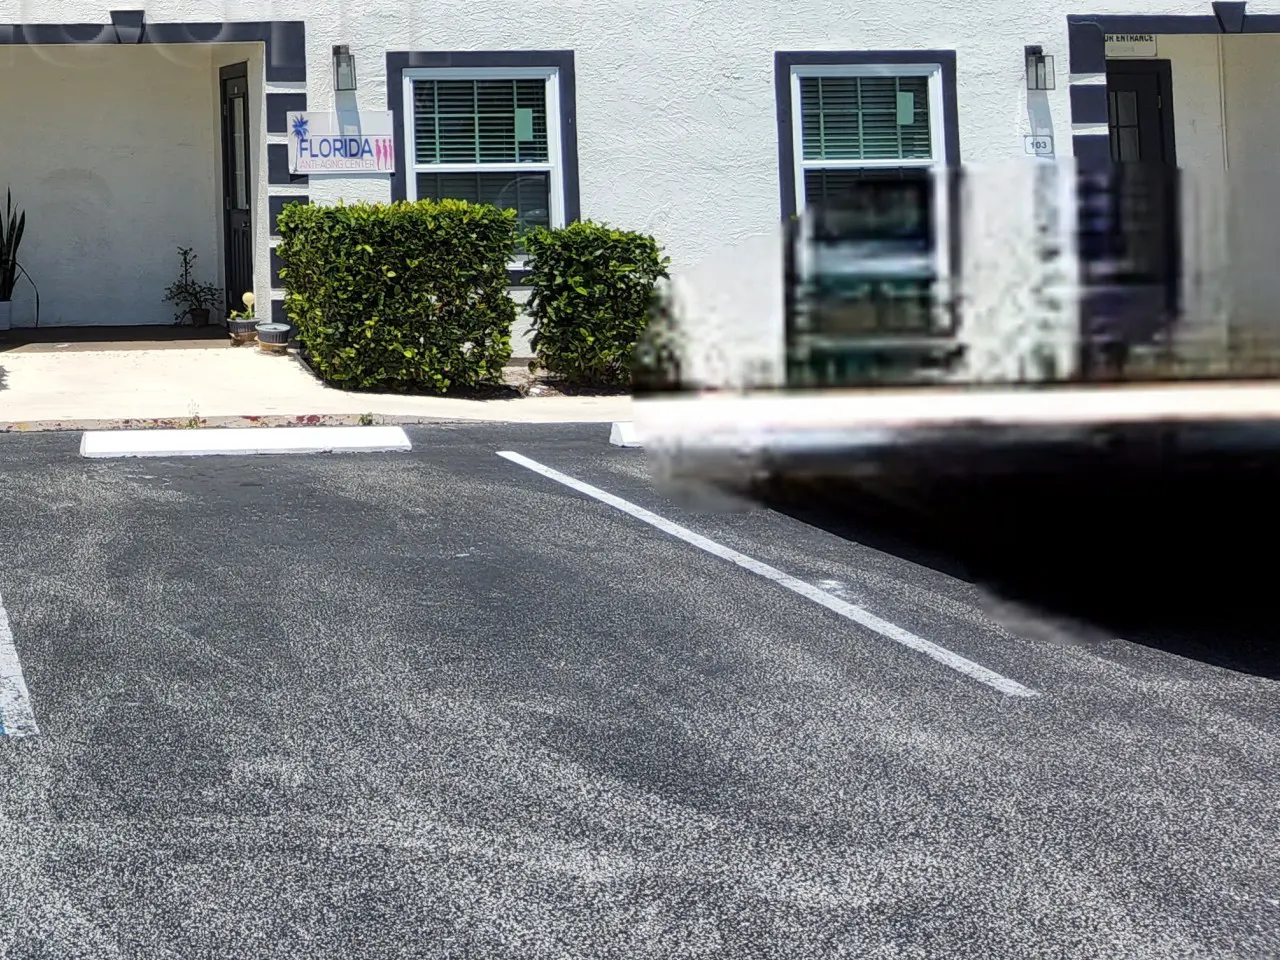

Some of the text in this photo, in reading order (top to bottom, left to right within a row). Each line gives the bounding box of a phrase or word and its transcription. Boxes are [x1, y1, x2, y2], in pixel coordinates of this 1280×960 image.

[299, 138, 374, 158] FLORIDA
[1030, 141, 1047, 149] 103
[300, 159, 375, 169] ANTI-AGING CENTER
